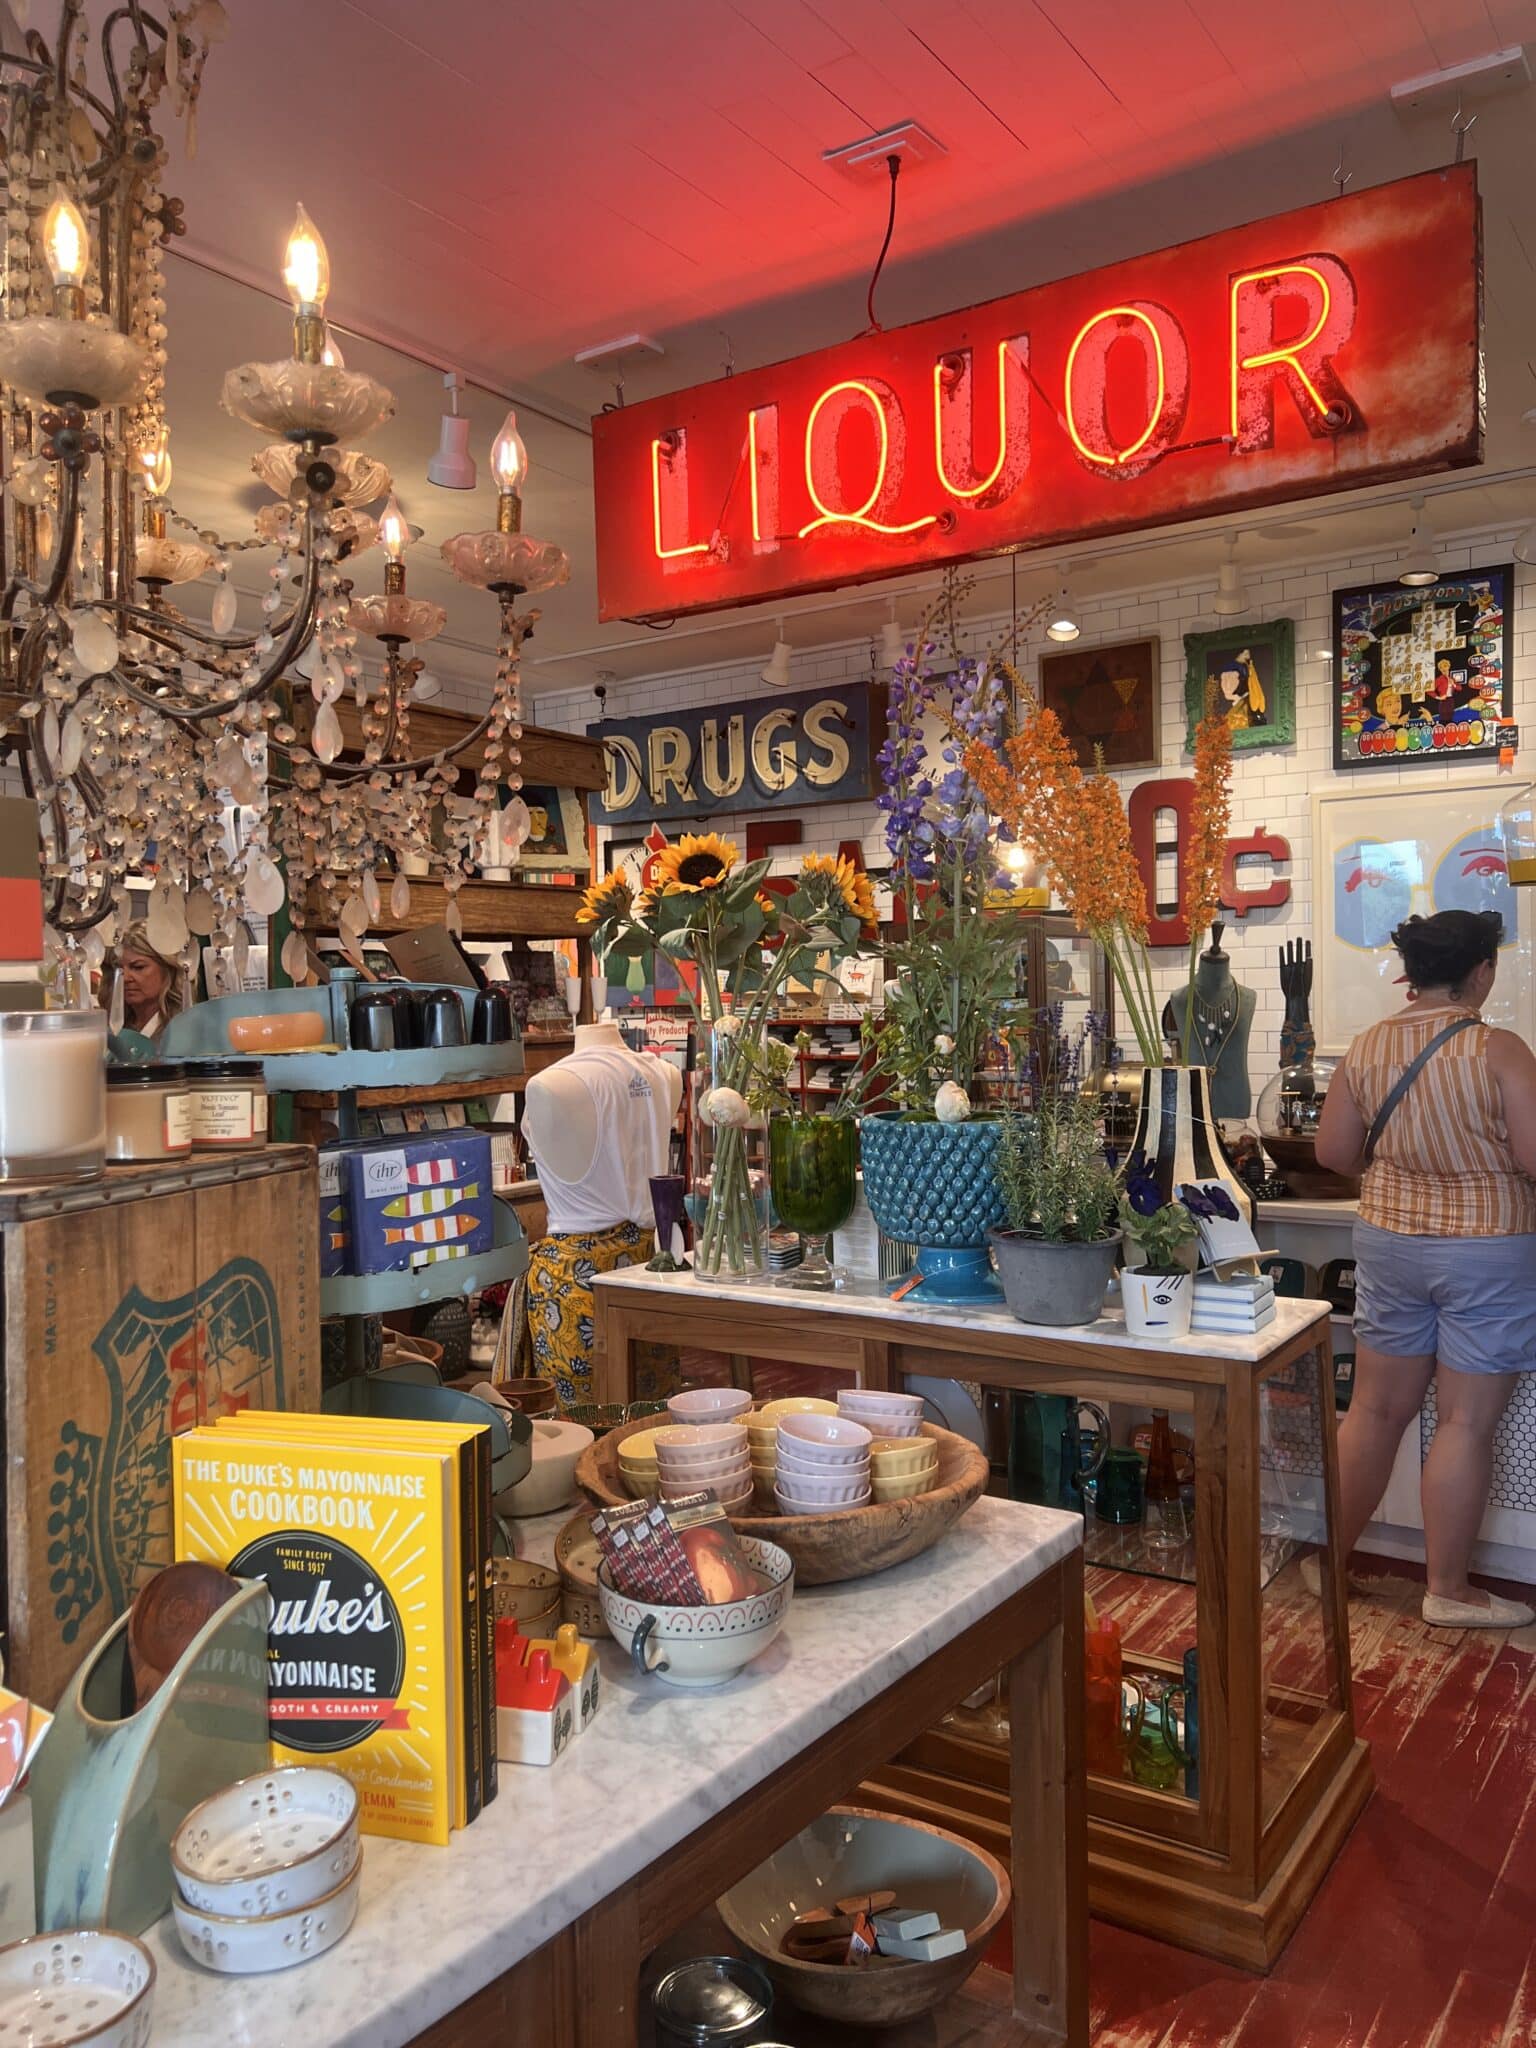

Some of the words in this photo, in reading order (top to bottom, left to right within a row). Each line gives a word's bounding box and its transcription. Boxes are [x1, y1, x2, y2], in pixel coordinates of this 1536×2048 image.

[651, 252, 1368, 575] LIQUOR
[601, 699, 850, 812] DRUGS
[183, 1459, 222, 1483] THE
[226, 1462, 293, 1488] DUKE'S
[298, 1467, 427, 1499] MAYONNAISE
[229, 1488, 375, 1531] COOKBOOK
[275, 1547, 302, 1558] FAMILY
[305, 1550, 333, 1561] RECIPE
[283, 1559, 305, 1572] SINCE
[308, 1561, 326, 1577] 1917
[268, 1660, 377, 1693] AYONNAISE
[270, 1704, 305, 1714] OOTH
[312, 1704, 320, 1714] &
[326, 1704, 379, 1714] CREAMY
[362, 1791, 396, 1809] EMAN
